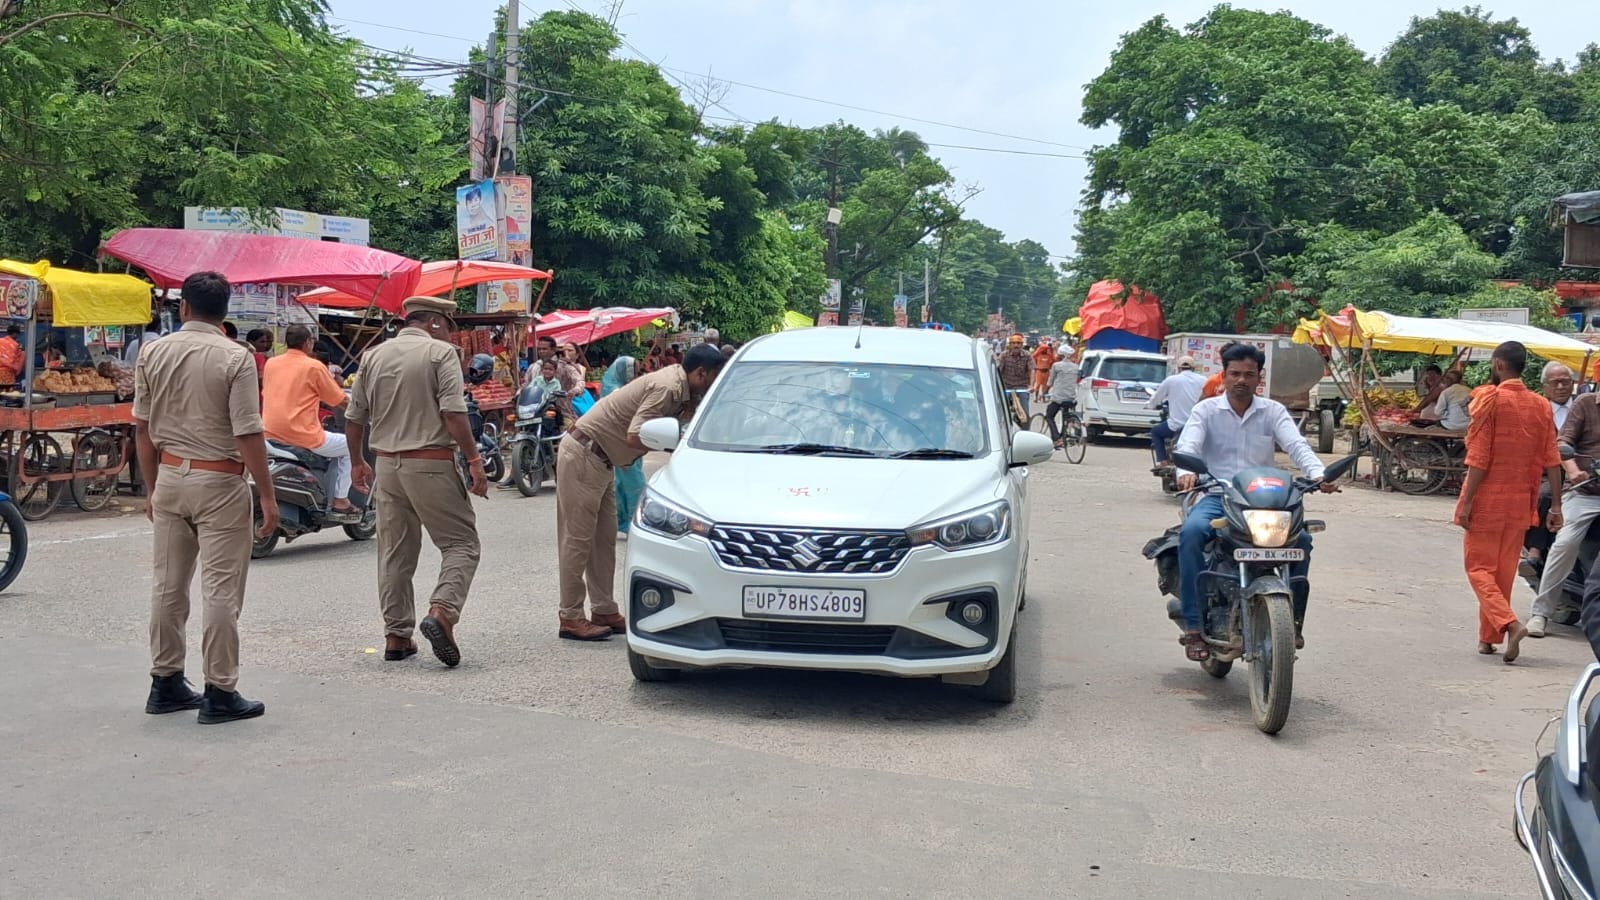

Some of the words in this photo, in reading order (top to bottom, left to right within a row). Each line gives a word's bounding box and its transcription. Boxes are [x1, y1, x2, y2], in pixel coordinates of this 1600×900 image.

[460, 233, 481, 248] तेजा
[482, 226, 496, 241] जी
[756, 592, 862, 613] UP78HS4809
